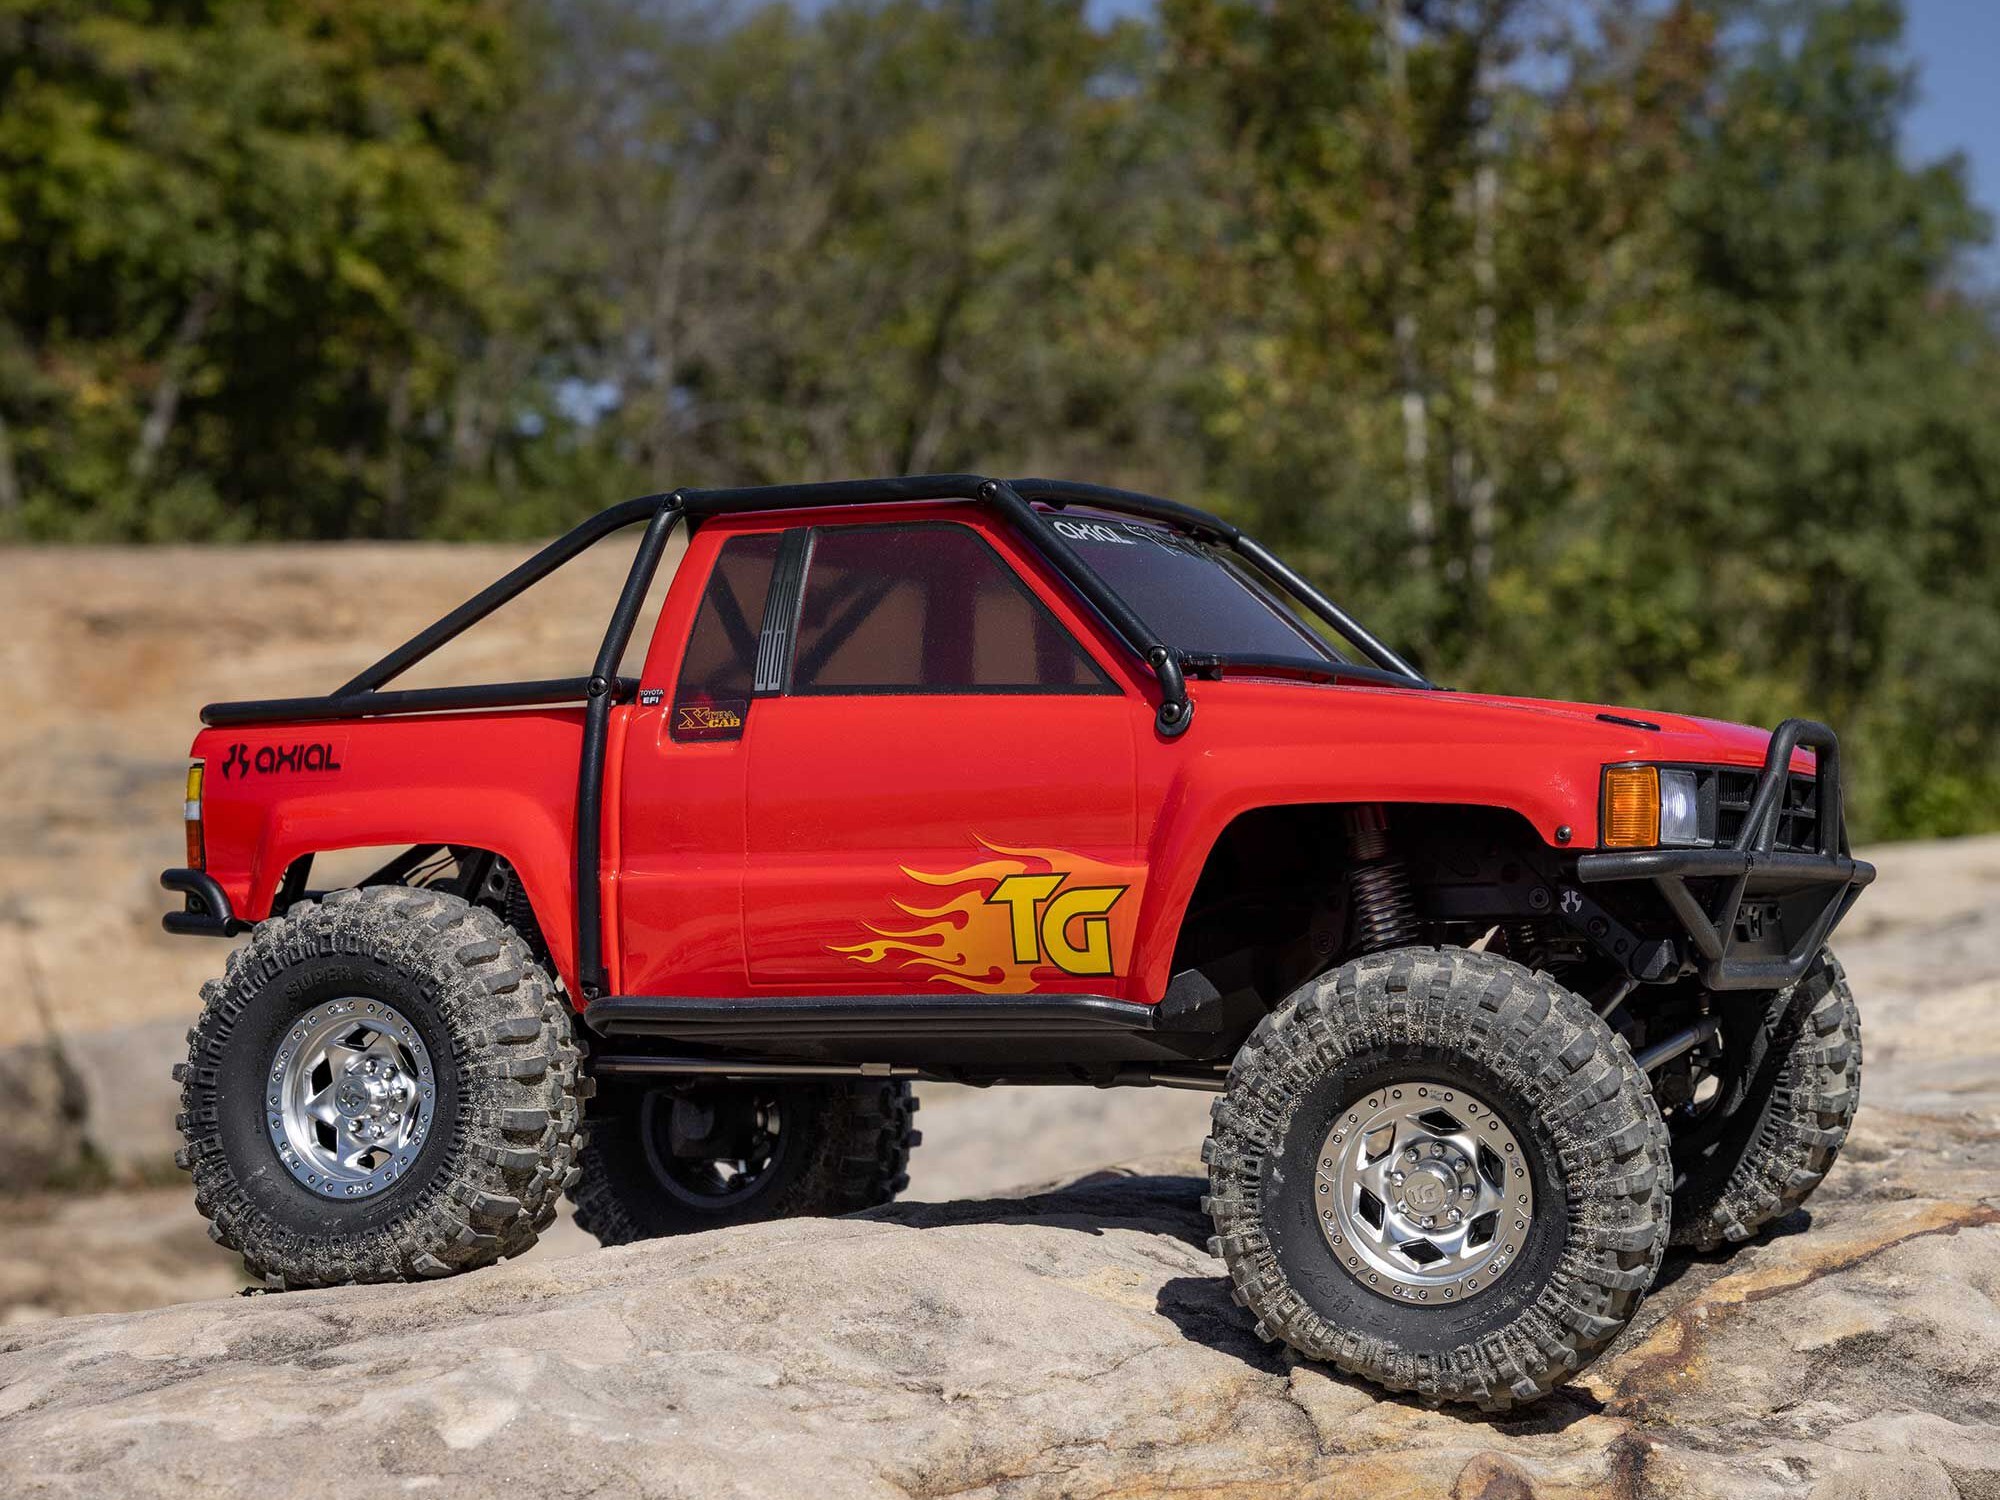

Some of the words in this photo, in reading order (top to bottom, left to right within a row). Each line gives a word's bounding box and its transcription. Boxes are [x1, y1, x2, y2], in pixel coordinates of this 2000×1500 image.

[640, 689, 665, 697] TOYOTA
[643, 696, 660, 705] EFI
[708, 717, 741, 729] CAB
[984, 872, 1131, 977] TG
